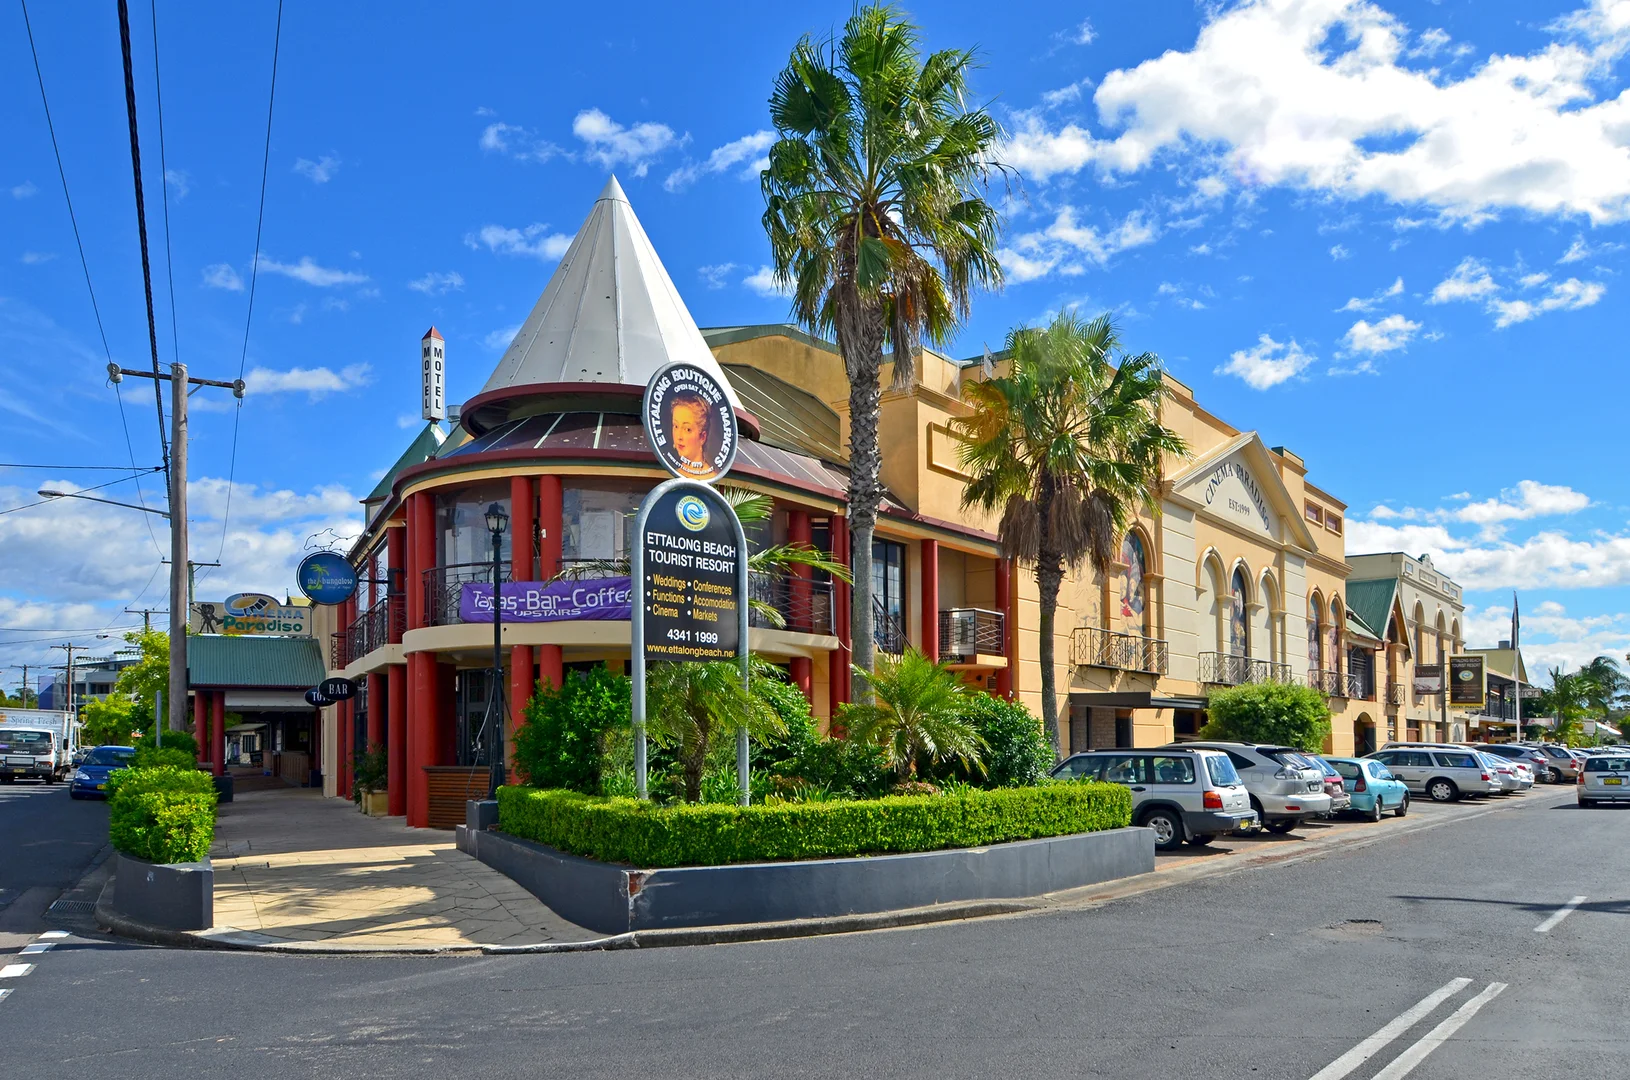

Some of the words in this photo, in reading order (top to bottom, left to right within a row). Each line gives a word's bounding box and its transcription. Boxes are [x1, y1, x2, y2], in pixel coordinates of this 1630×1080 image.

[434, 347, 442, 410] MOTEL
[650, 376, 672, 447] ETTALONG
[671, 369, 722, 403] BOUTIQUE
[714, 406, 732, 468] MARKETS
[1205, 462, 1233, 504] CINEMA
[1236, 464, 1270, 530] PARADISO
[647, 532, 700, 552] ETTALONG
[704, 542, 736, 558] BEACH
[649, 550, 694, 568] TOURIST
[696, 557, 734, 574] RESORT
[322, 577, 353, 586] bungalow
[653, 574, 686, 592] Weddings
[693, 580, 732, 596] Conferences
[652, 589, 685, 604] Functions
[514, 608, 582, 618] UPSTAIRS
[652, 604, 678, 618] Cinema
[692, 608, 718, 622] Markets
[223, 616, 303, 632] Paradiso
[666, 629, 690, 642] 4341
[694, 632, 718, 644] 1999
[646, 644, 735, 658] www.ettalongbeach.net
[328, 684, 348, 694] BAR
[38, 716, 57, 725] Fresh
